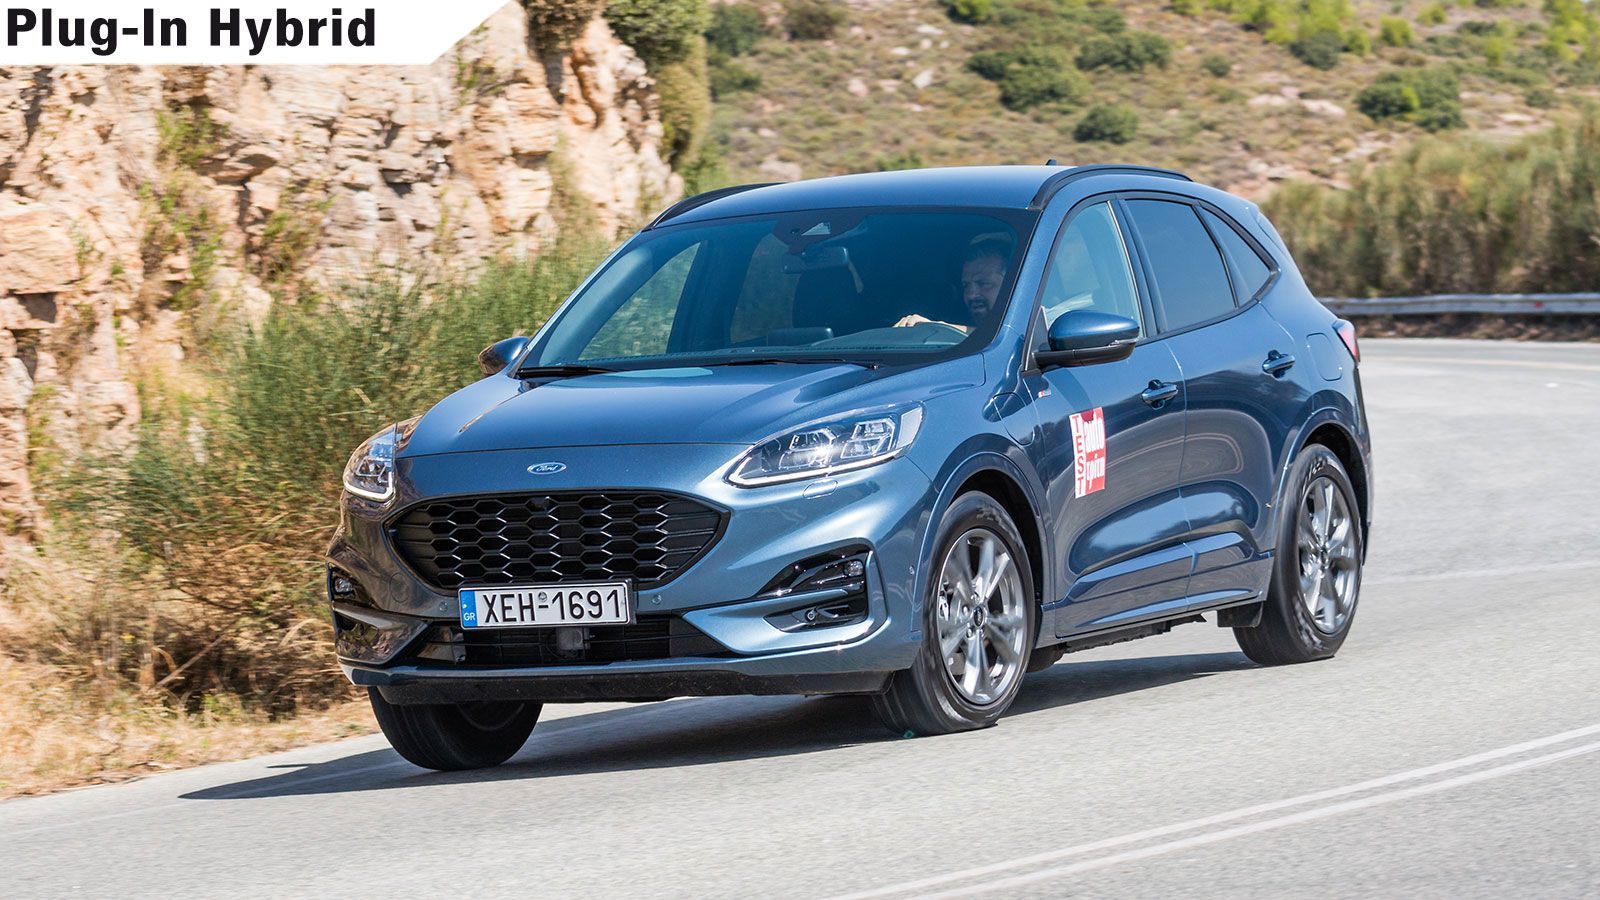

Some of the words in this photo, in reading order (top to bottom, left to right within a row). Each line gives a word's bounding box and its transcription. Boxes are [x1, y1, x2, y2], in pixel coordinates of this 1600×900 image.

[1072, 414, 1084, 495] TEST
[463, 612, 476, 621] GR
[483, 589, 620, 623] XEH-1691
